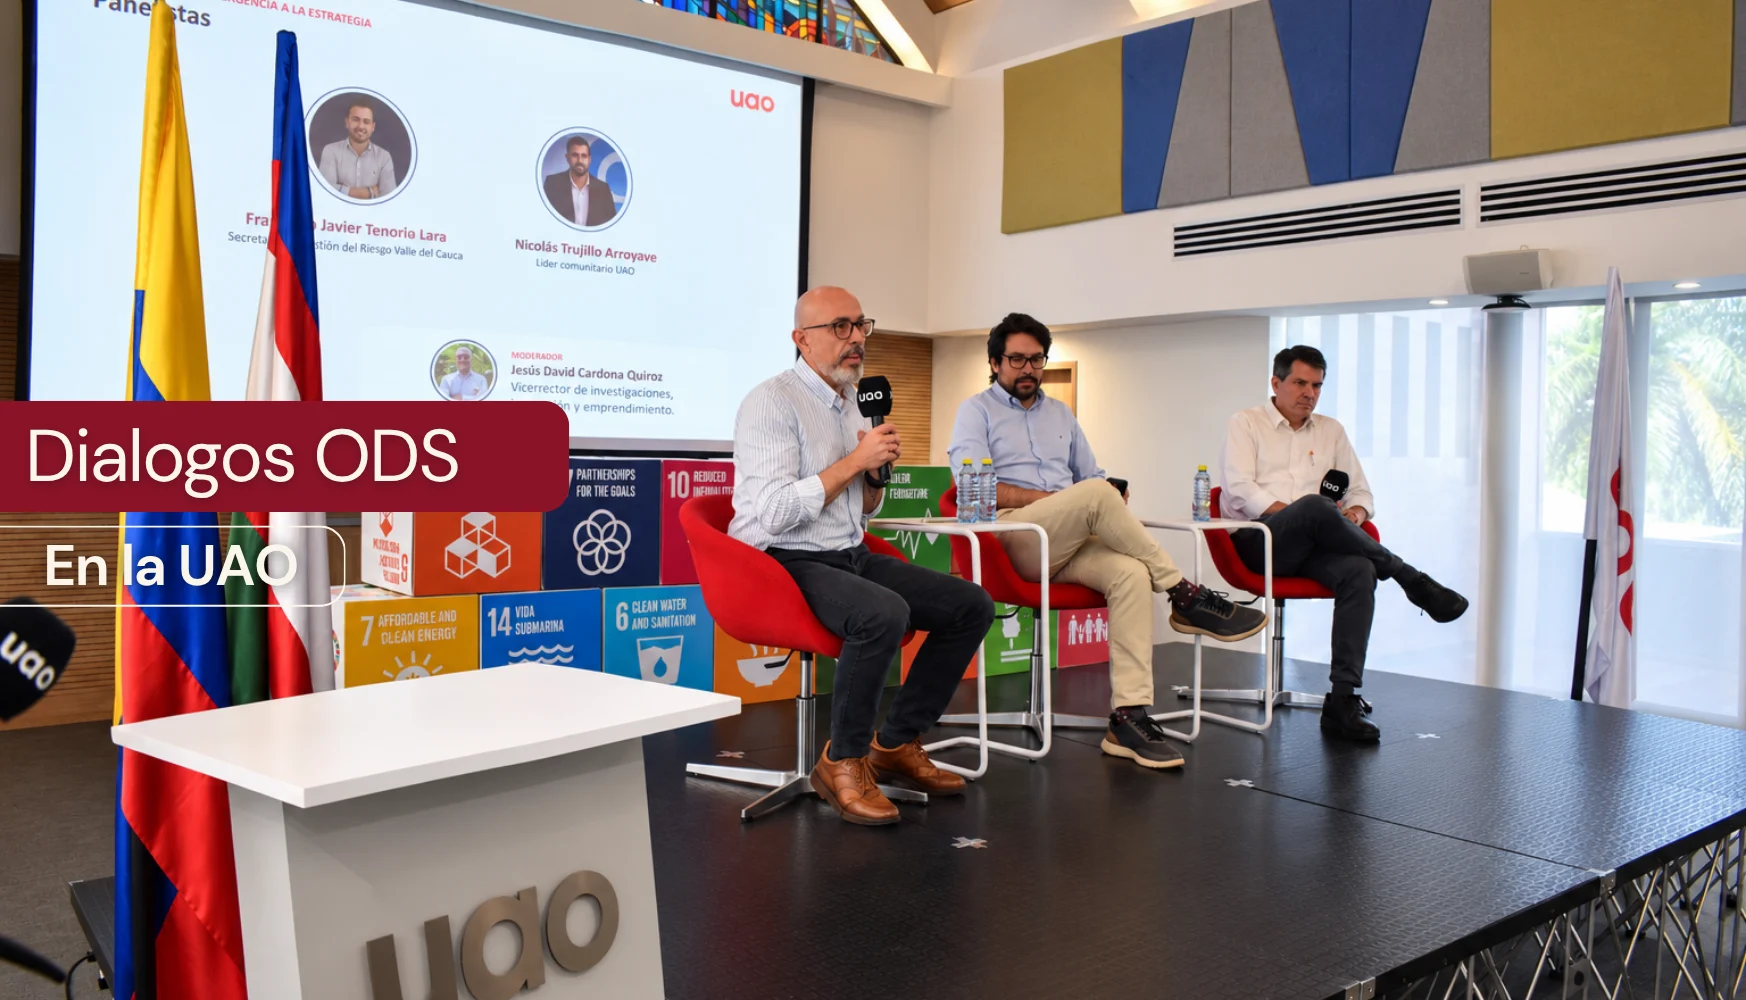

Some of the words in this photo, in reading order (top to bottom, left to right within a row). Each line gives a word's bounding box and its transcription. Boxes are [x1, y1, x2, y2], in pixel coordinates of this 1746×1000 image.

[94, 0, 210, 26] anetas
[281, 4, 290, 12] A
[292, 5, 306, 16] LA
[308, 8, 372, 28] ESTRATEGIA
[730, 89, 775, 113] uao
[320, 218, 361, 234] Javier
[365, 223, 416, 240] Tenorio
[420, 229, 447, 242] Lara
[228, 231, 268, 245] Secreta
[315, 240, 339, 251] stión
[342, 242, 358, 252] del
[360, 243, 392, 256] Riesgo
[394, 246, 416, 256] Valle
[419, 248, 434, 257] del
[436, 249, 464, 260] Cauca
[515, 239, 558, 253] Nicolás
[561, 243, 602, 258] Trujillo
[605, 248, 657, 263] Arroyave
[560, 262, 613, 274] comunitario
[616, 266, 635, 275] UAO
[511, 351, 563, 361] MODERADOR
[511, 365, 541, 376] Jesús
[543, 366, 575, 378] David
[578, 369, 624, 380] Cardona
[627, 370, 663, 382] Quiroz
[511, 382, 571, 395] Vicerrector
[574, 384, 588, 396] de
[590, 385, 674, 400] investigaciones,
[858, 391, 883, 402] uao
[574, 404, 580, 413] y
[583, 402, 675, 415] emprendimiento.
[576, 468, 636, 481] PARTNERSHIPS
[693, 471, 727, 482] REDUCED
[576, 485, 591, 497] FOR
[594, 485, 608, 497] THE
[610, 485, 636, 497] GOALS
[668, 471, 690, 499] 10
[515, 606, 535, 618] VIDA
[632, 600, 658, 614] CLEAN
[660, 598, 687, 611] WATER
[378, 611, 436, 627] AFFORDABLE
[438, 610, 457, 622] AND
[487, 607, 512, 637] 14
[616, 602, 629, 631] 6
[632, 616, 648, 630] AND
[651, 614, 696, 628] SANITATION
[361, 615, 374, 646] 7
[418, 627, 457, 642] ENERGY
[515, 620, 564, 635] SUBMARINA
[0, 631, 55, 691] uao
[366, 869, 619, 1000] uao
